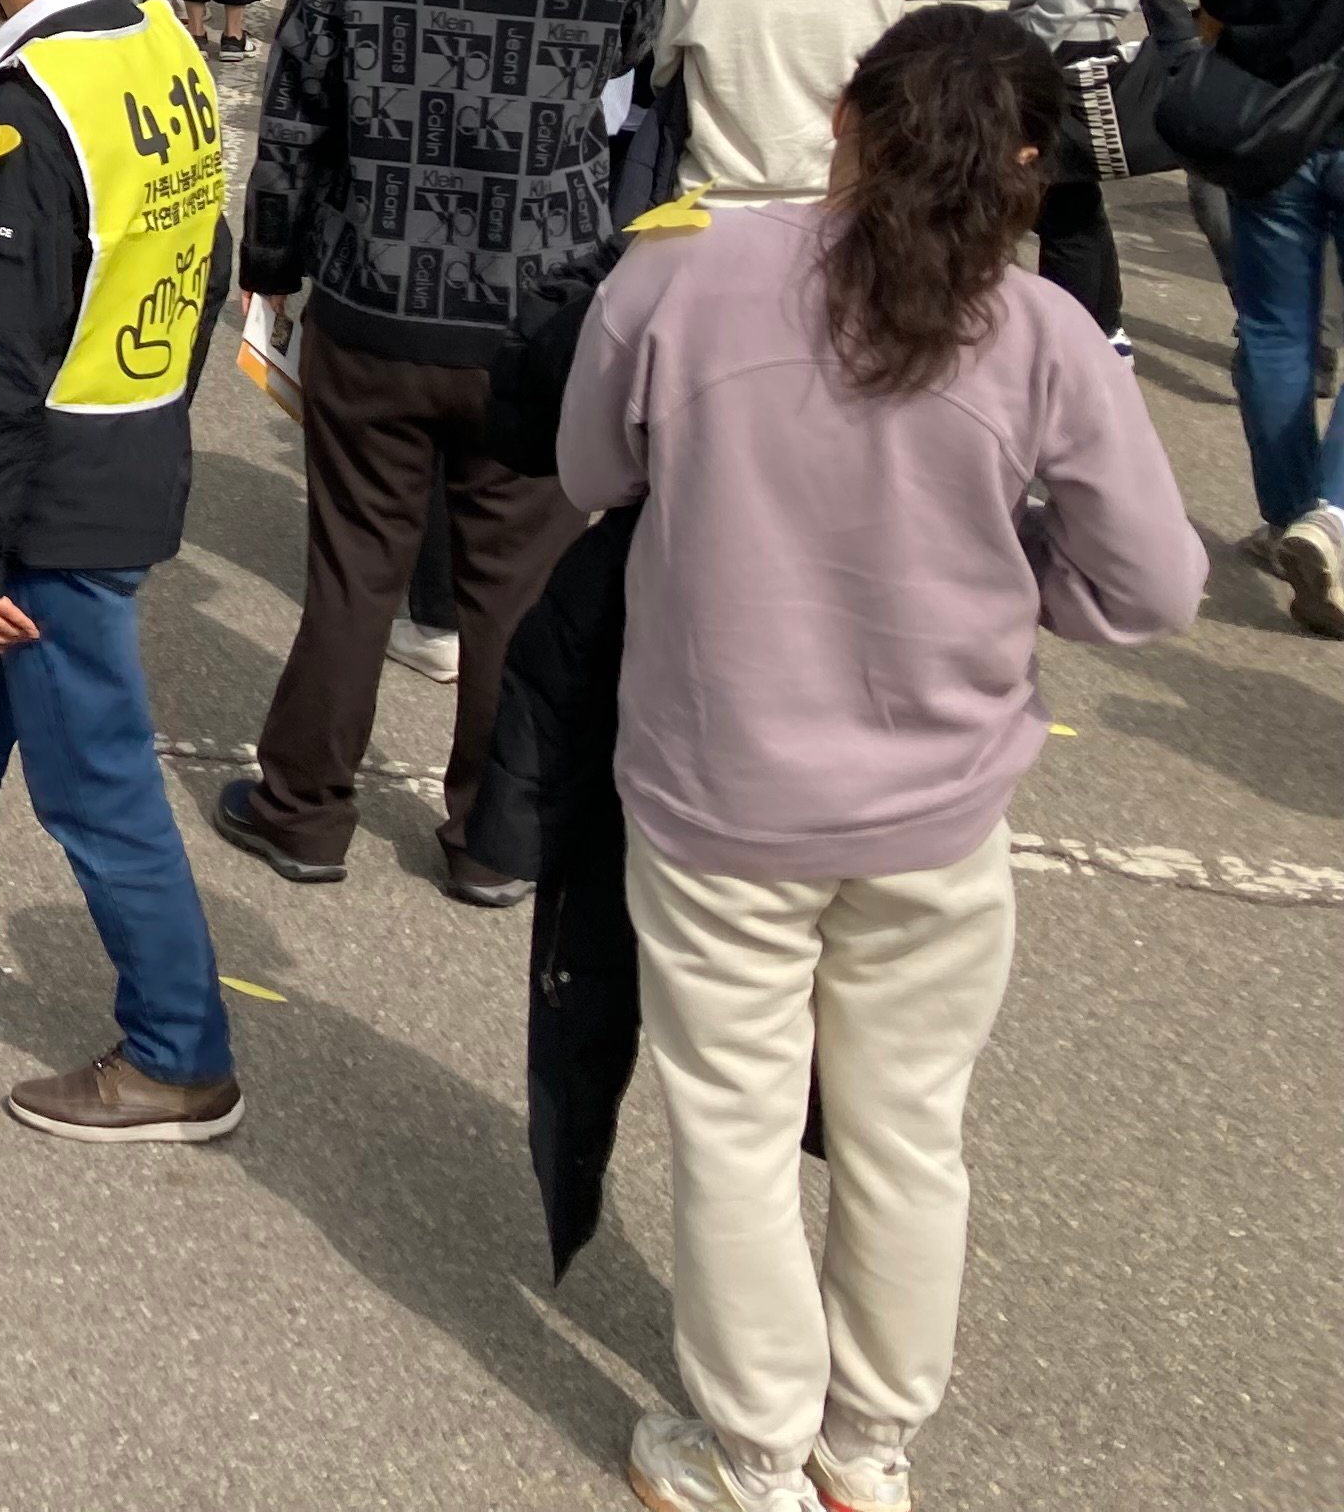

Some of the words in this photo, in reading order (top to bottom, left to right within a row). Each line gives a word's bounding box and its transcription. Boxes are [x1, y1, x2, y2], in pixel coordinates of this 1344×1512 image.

[392, 14, 408, 75] Jeans
[431, 10, 474, 34] Klein
[548, 22, 590, 43] Klein
[505, 27, 521, 86] Jeans
[427, 98, 448, 157] Calvin
[535, 109, 557, 168] Calvin
[384, 172, 404, 230] Jeans
[423, 169, 463, 188] Klein
[142, 201, 181, 233] 자연을
[488, 185, 510, 243] Jeans
[415, 254, 434, 310] Calvin
